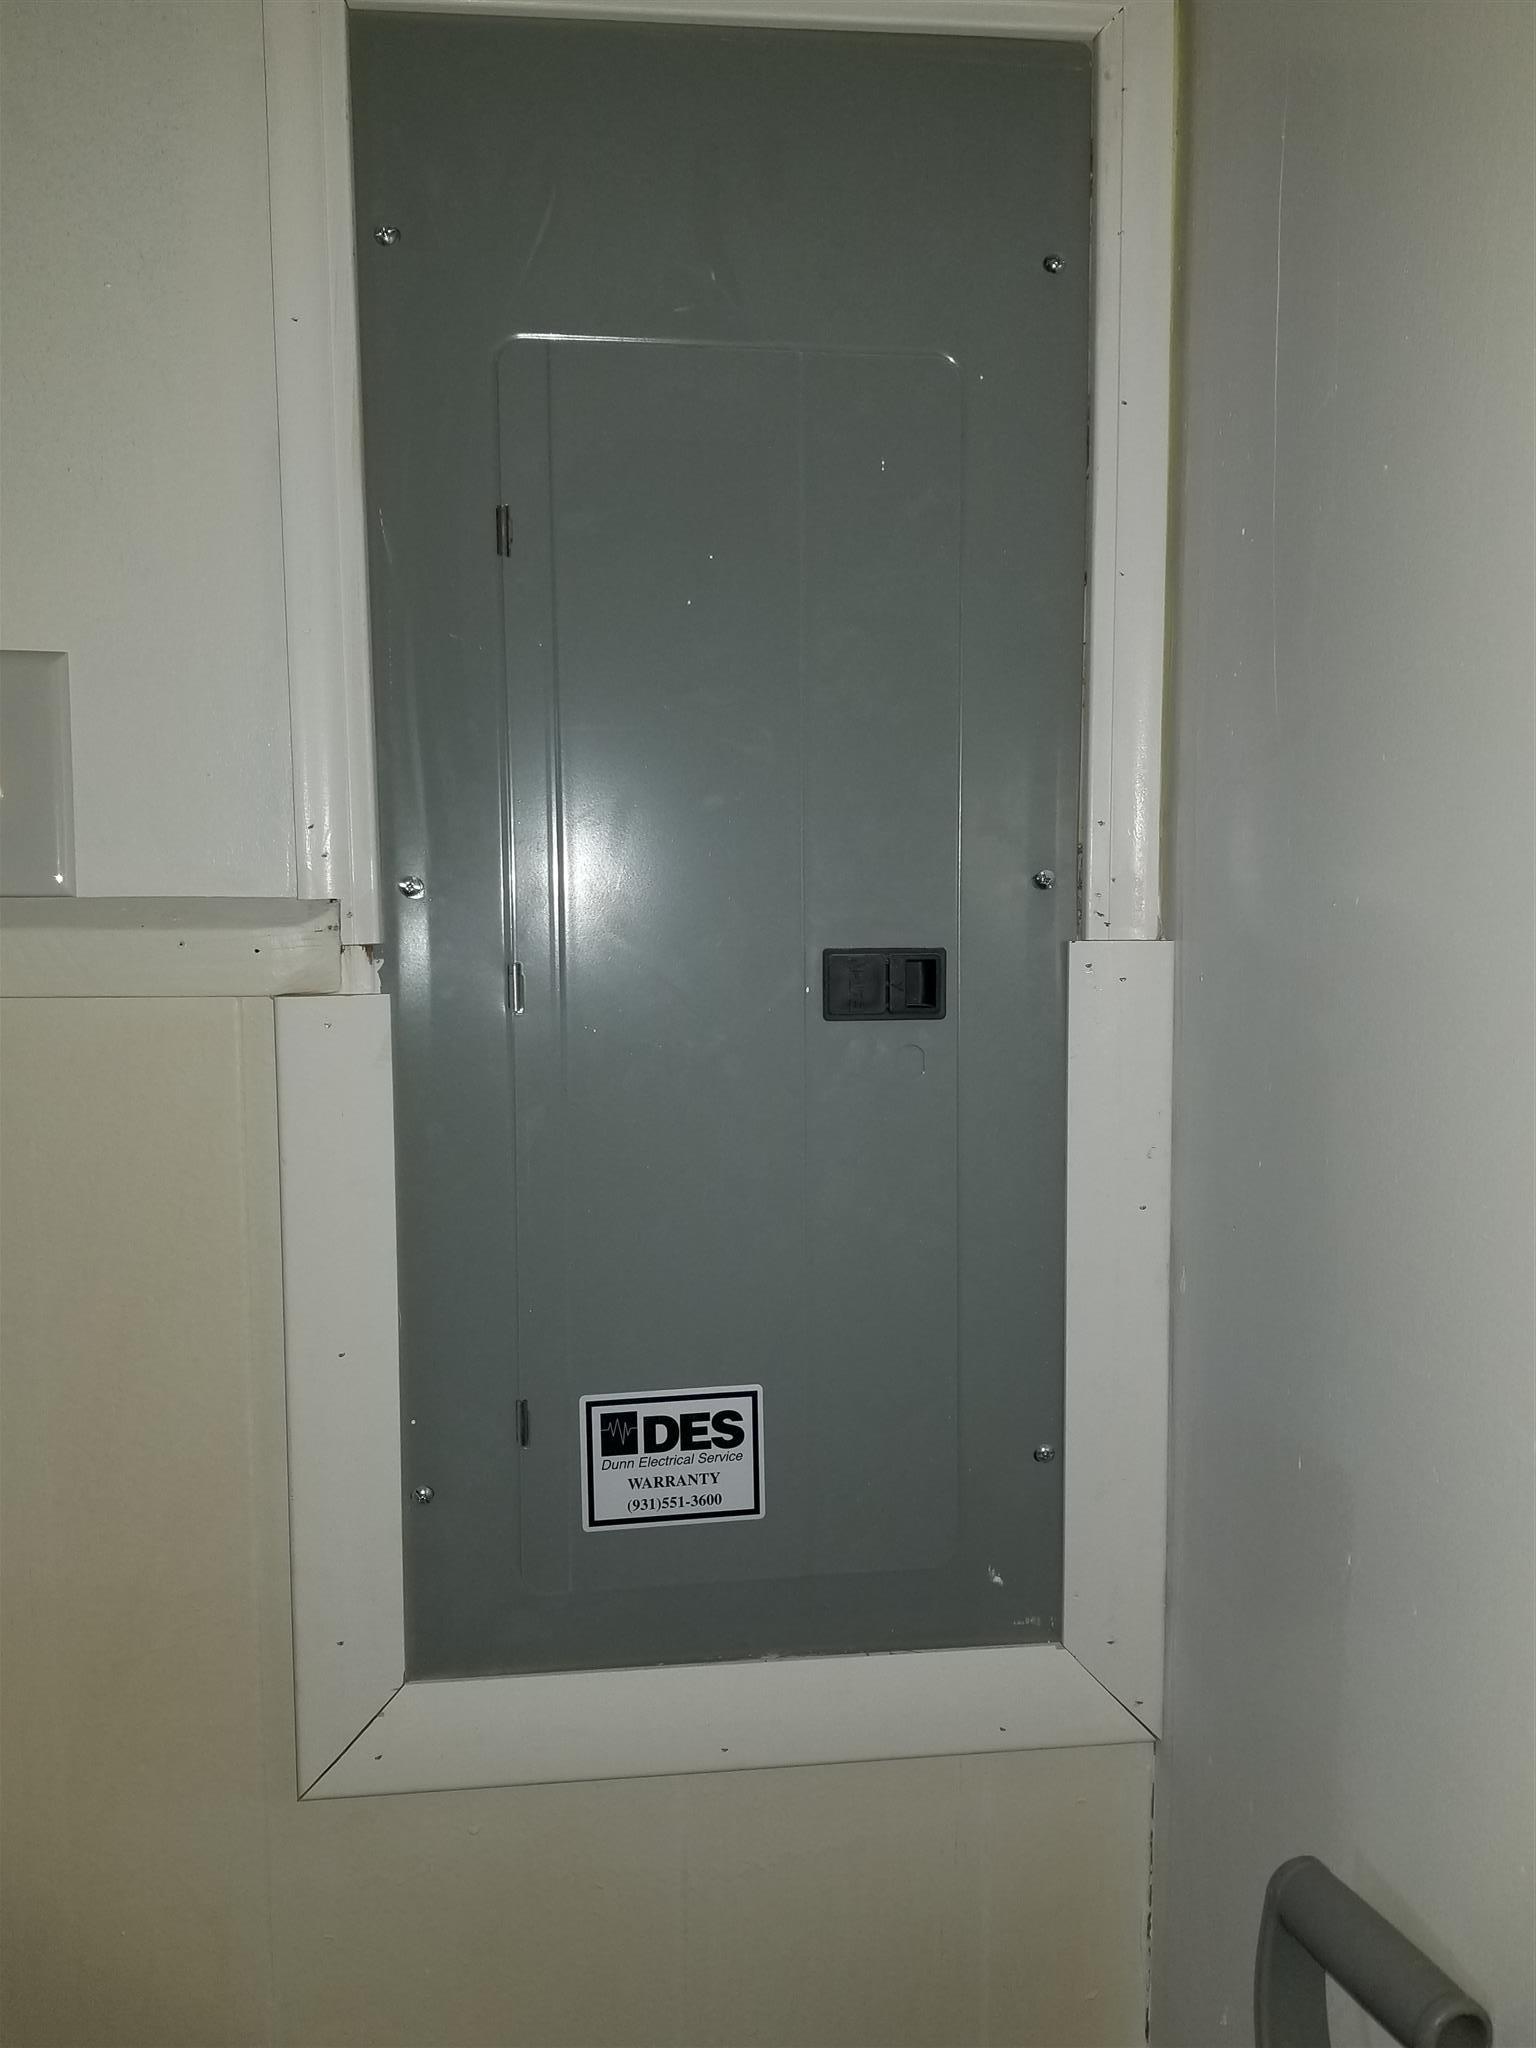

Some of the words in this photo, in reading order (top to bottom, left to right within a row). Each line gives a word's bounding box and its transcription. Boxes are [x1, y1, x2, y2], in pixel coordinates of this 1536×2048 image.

[643, 1410, 745, 1454] DES
[601, 1459, 635, 1471] Dunn
[638, 1453, 695, 1468] Electrical
[697, 1451, 744, 1464] Service
[627, 1472, 721, 1490] WARRANTY
[627, 1493, 723, 1513] (931)551-3600
